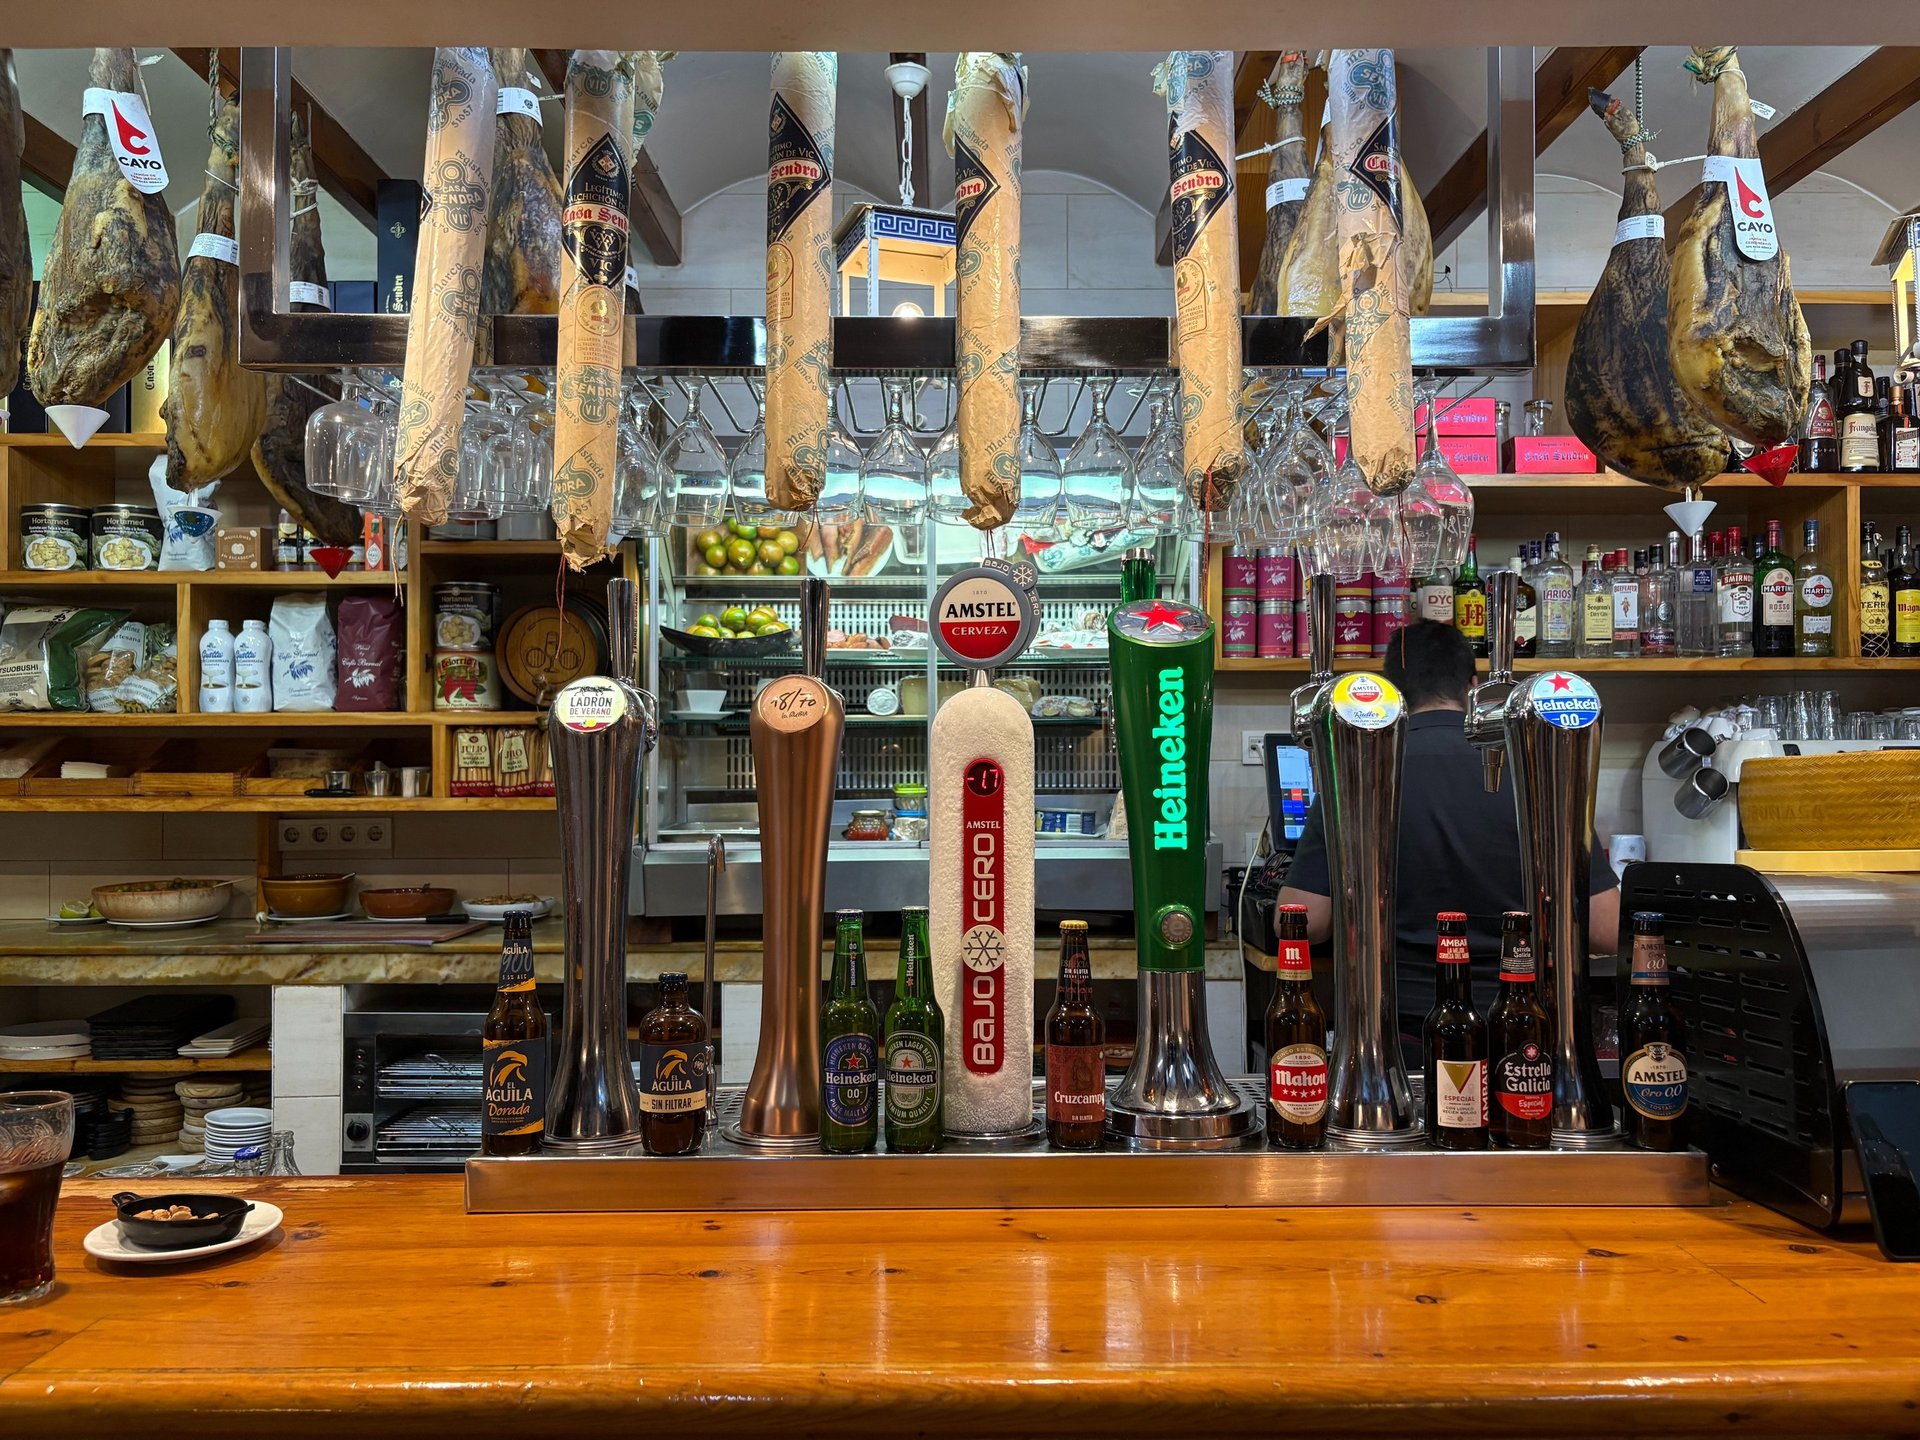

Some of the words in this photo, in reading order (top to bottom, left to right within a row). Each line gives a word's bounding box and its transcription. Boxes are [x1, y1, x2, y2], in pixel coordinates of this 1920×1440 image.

[786, 150, 796, 158] DE
[798, 147, 815, 159] VIC
[119, 157, 162, 170] CAYO
[771, 161, 818, 180] Sendra
[1187, 162, 1197, 172] DE
[1198, 158, 1215, 169] VIC
[455, 149, 491, 194] registrada
[963, 168, 977, 178] VIC
[957, 182, 981, 199] ndra
[1172, 174, 1223, 198] Sendra
[433, 191, 483, 205] SENDRA
[1352, 193, 1368, 203] VIC
[452, 213, 469, 225] VIC
[597, 208, 628, 232] Send
[1737, 222, 1773, 233] CAYO
[966, 230, 990, 251] strada
[583, 376, 607, 385] CASA
[1181, 363, 1212, 398] registrada
[585, 404, 605, 416] VIC
[785, 420, 821, 448] Marca
[985, 428, 1018, 456] Marca
[32, 517, 69, 526] Hortamed
[106, 517, 145, 526] Hortamed
[1543, 590, 1571, 600] LARIOS
[946, 602, 1015, 618] AMSTEL
[951, 626, 1007, 636] CERVEZA
[0, 664, 39, 674] TSUOBUSHI
[1534, 698, 1598, 711] Heineken
[581, 708, 611, 716] VERANO
[1152, 665, 1188, 850] Heineken
[966, 820, 1001, 829] AMSTEL
[972, 832, 995, 922] CERO
[906, 934, 915, 977] Heineken
[904, 1040, 924, 1050] LAGER
[922, 1047, 933, 1064] BEER
[1503, 1061, 1551, 1077] Estrella
[825, 1071, 877, 1085] Heineken
[886, 1070, 933, 1083] Heineken
[1275, 1069, 1326, 1086] Mahou
[1633, 1070, 1685, 1083] AMSTEL
[507, 1081, 516, 1089] EL
[1506, 1076, 1551, 1092] Galicia
[485, 1086, 533, 1102] ÁGUILA
[1055, 1091, 1103, 1105] Cruzcamp
[1641, 1088, 1662, 1097] Oro
[488, 1102, 531, 1116] Dorada
[651, 1099, 663, 1110] SIN
[664, 1097, 692, 1110] FILTRAR
[908, 1096, 932, 1118] QUALITY
[1518, 1097, 1545, 1108] Especial
